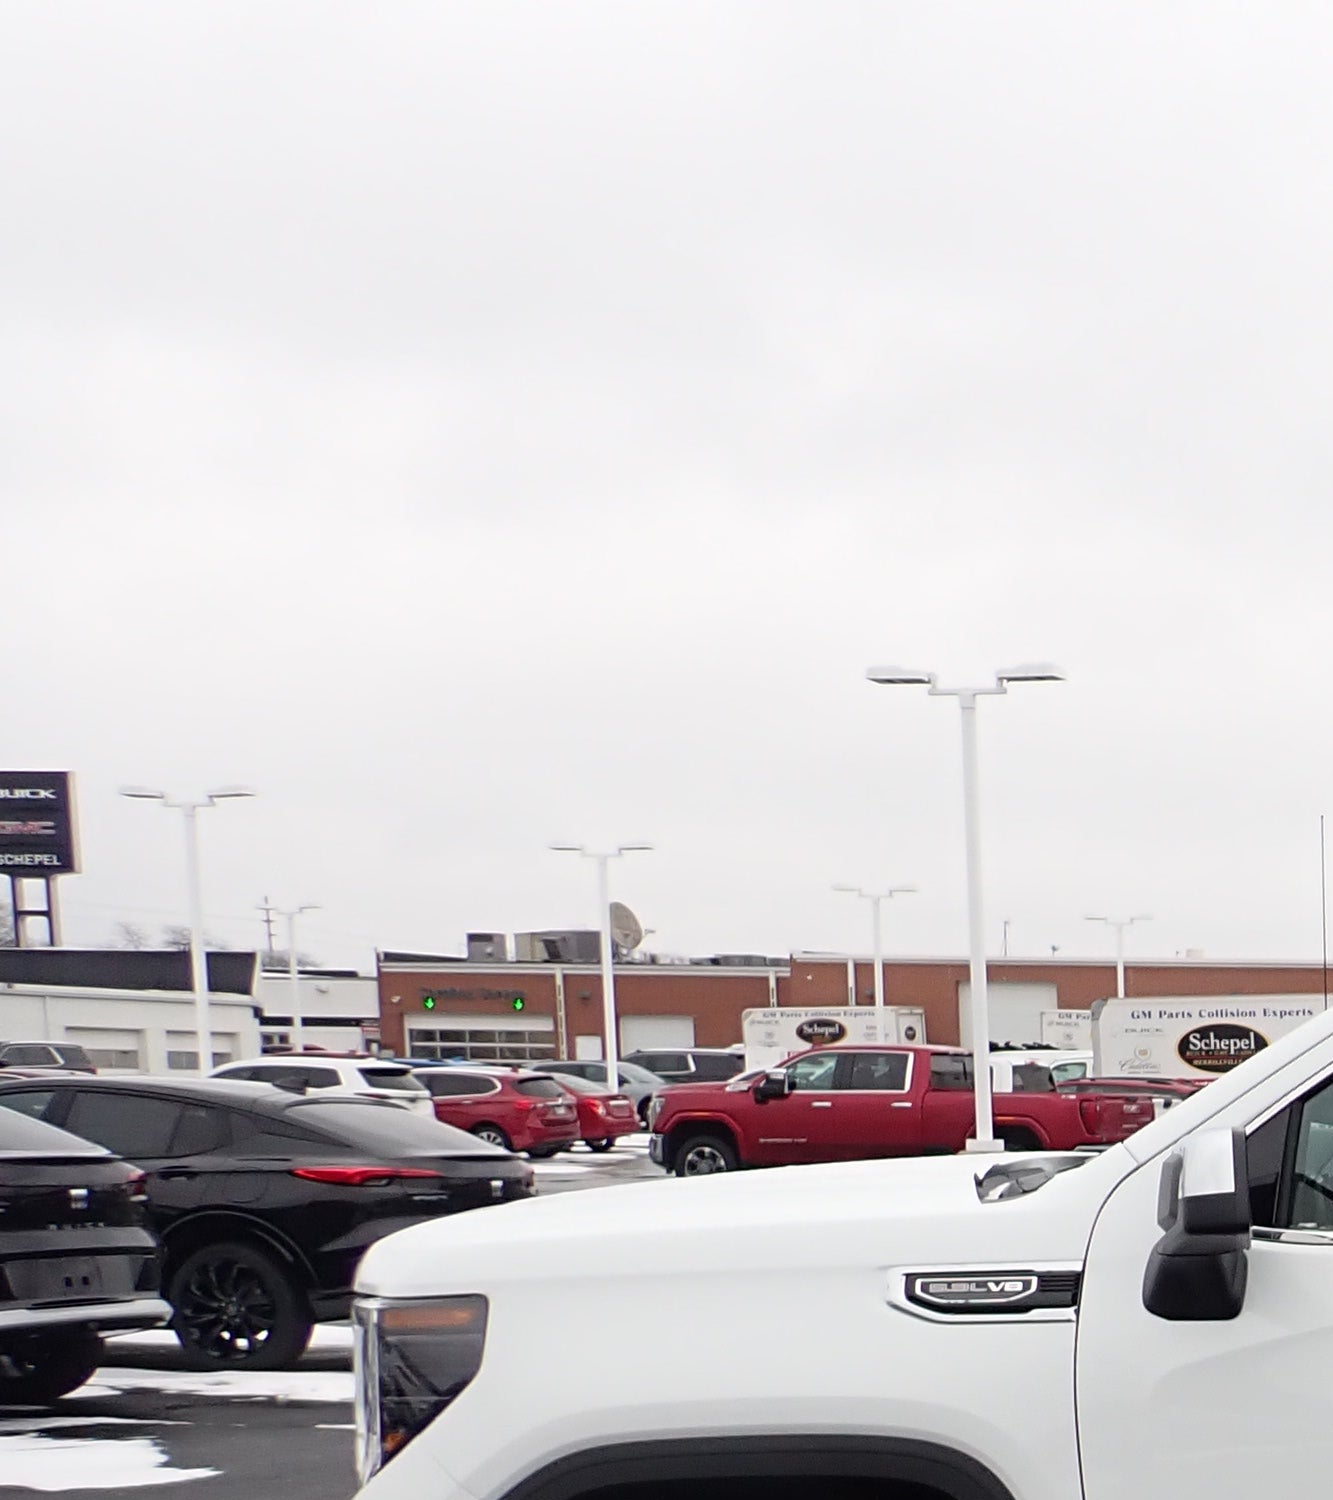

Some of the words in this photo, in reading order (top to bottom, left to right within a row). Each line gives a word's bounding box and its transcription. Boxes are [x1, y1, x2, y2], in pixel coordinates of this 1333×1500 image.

[1131, 1010, 1152, 1020] GM
[1159, 1009, 1193, 1019] Parts
[1198, 1008, 1256, 1019] Collision
[1263, 1007, 1314, 1019] Experts
[803, 1023, 839, 1037] Schepel
[1189, 1032, 1255, 1054] Schepel
